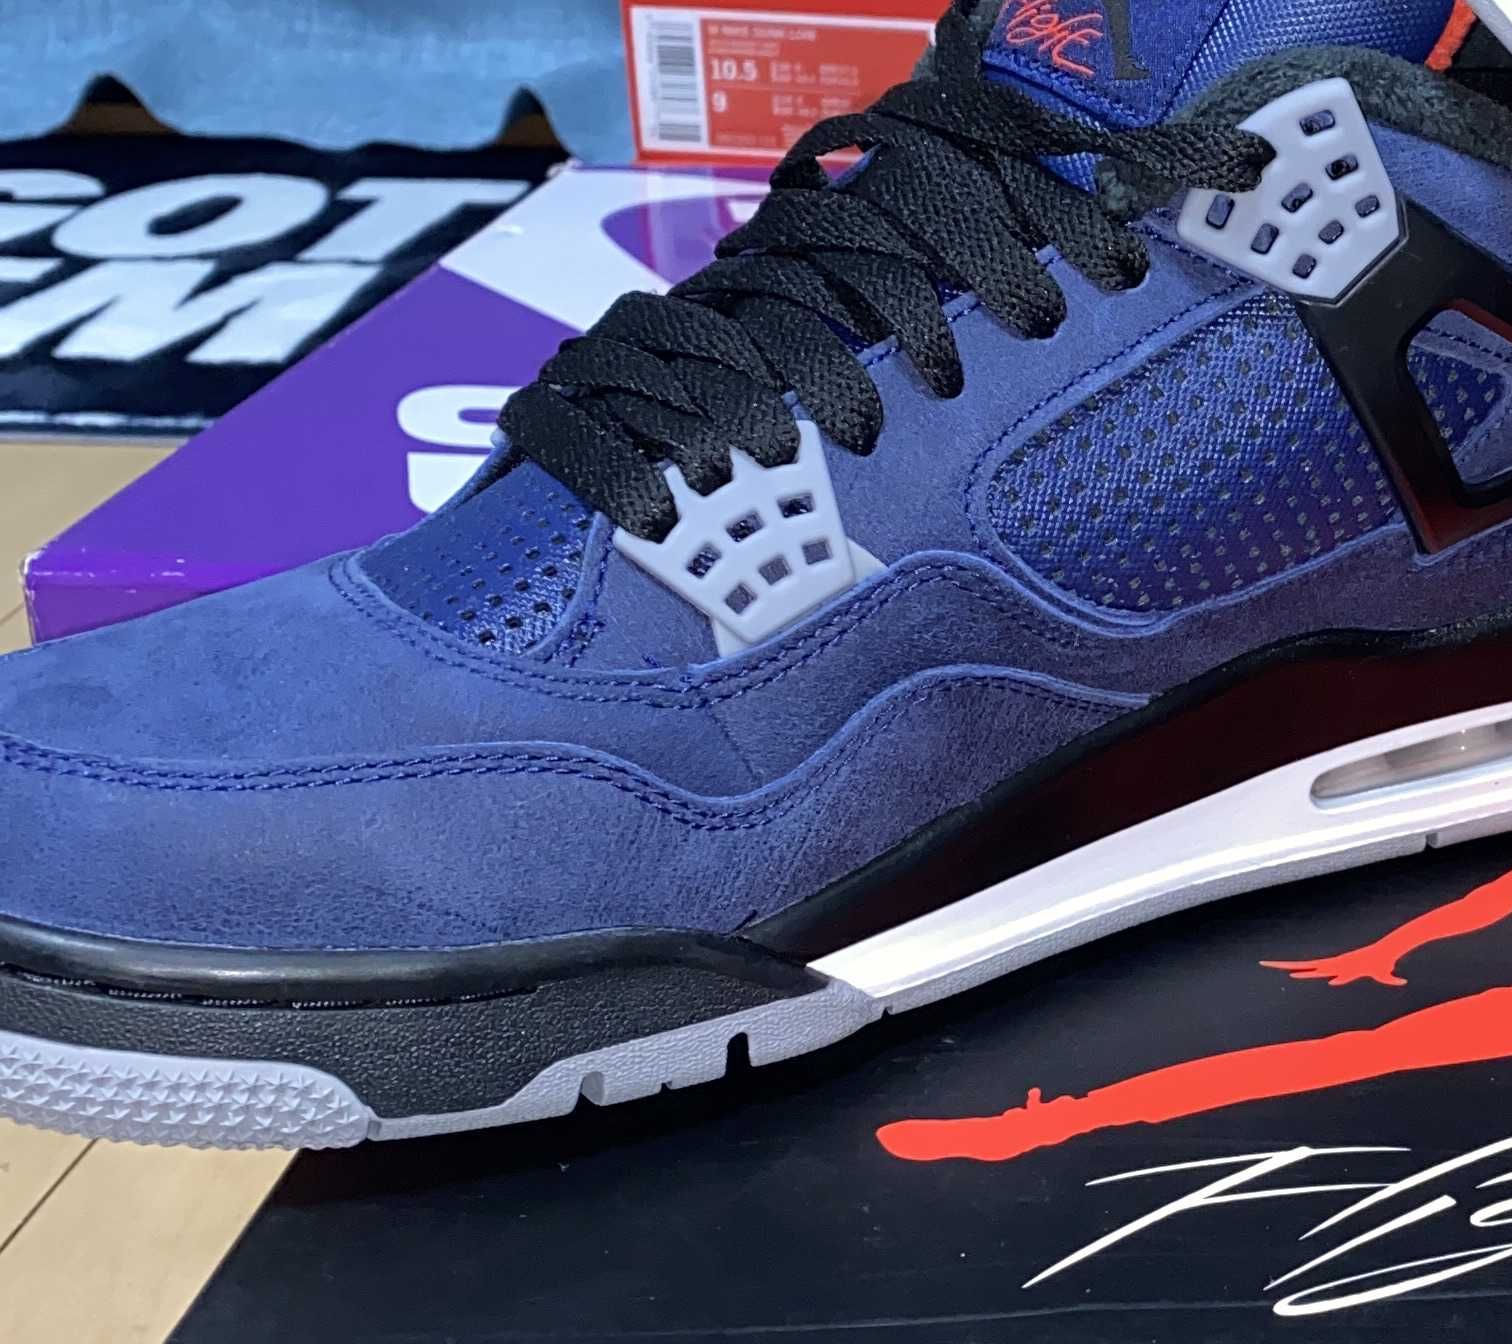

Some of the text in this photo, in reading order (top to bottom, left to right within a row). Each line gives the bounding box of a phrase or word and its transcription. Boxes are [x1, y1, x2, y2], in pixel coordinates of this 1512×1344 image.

[710, 58, 758, 82] 10.5
[712, 90, 728, 113] 9
[0, 256, 386, 364] M
